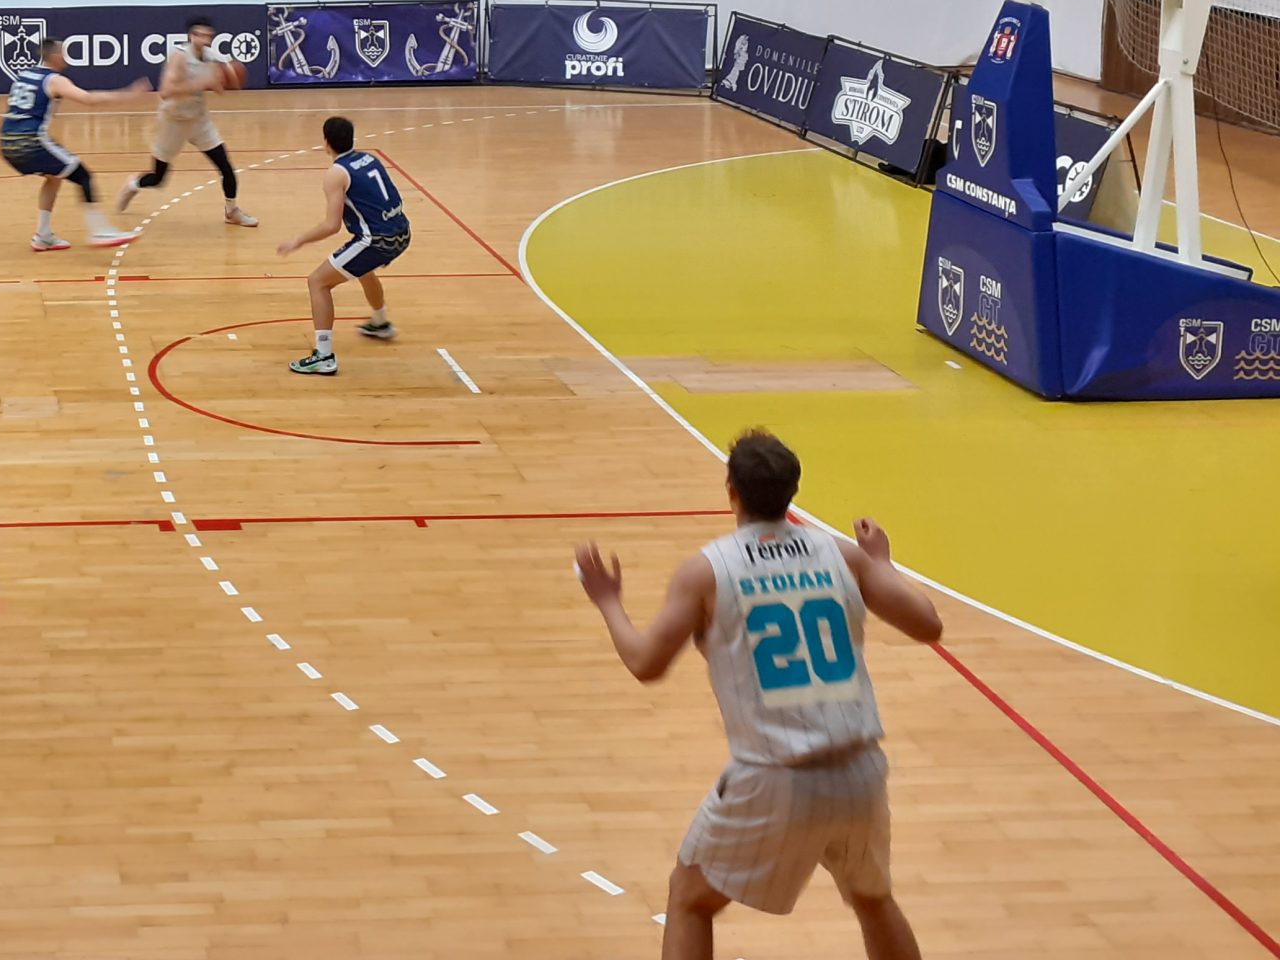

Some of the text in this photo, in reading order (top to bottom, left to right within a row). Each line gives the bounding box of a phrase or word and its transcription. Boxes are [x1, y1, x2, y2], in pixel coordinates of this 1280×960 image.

[353, 18, 371, 26] CSM
[564, 56, 625, 80] profi
[755, 44, 820, 75] DOMENIILE
[747, 62, 815, 110] OVIDIU
[842, 96, 895, 133] STIROM
[946, 172, 964, 192] CSM
[980, 274, 1002, 299] CSM
[1179, 318, 1202, 328] CSM
[746, 597, 857, 692] 20
